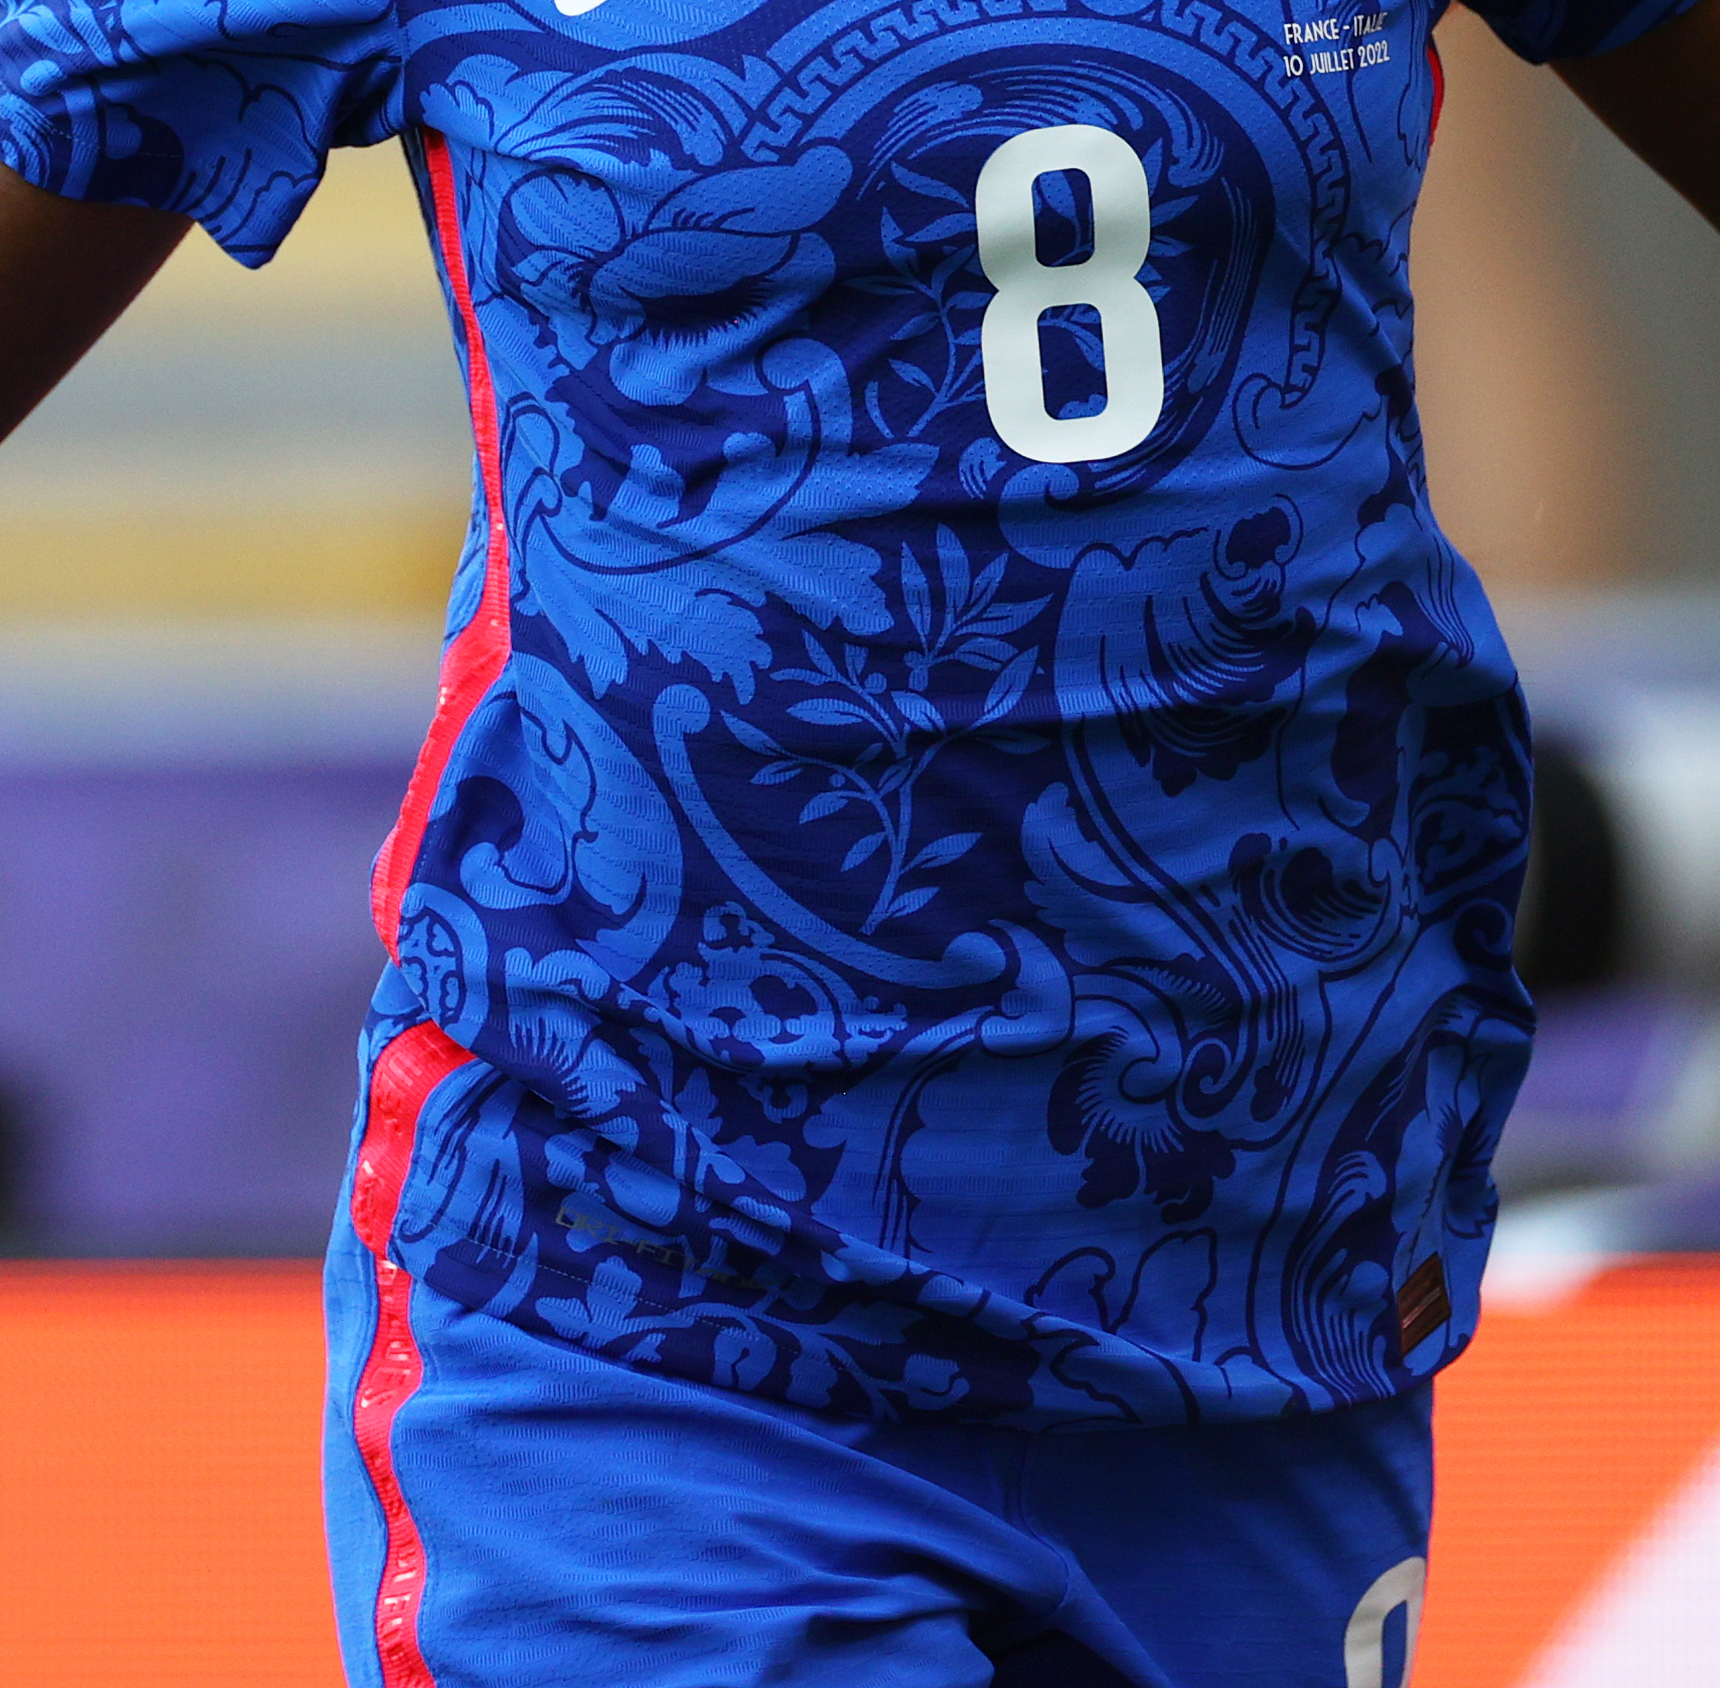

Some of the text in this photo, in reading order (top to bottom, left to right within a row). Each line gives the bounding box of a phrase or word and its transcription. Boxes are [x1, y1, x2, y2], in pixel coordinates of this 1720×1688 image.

[1283, 18, 1340, 45] FRANCE
[1283, 39, 1391, 78] 10 JUILLET 2022
[975, 123, 1165, 464] 8
